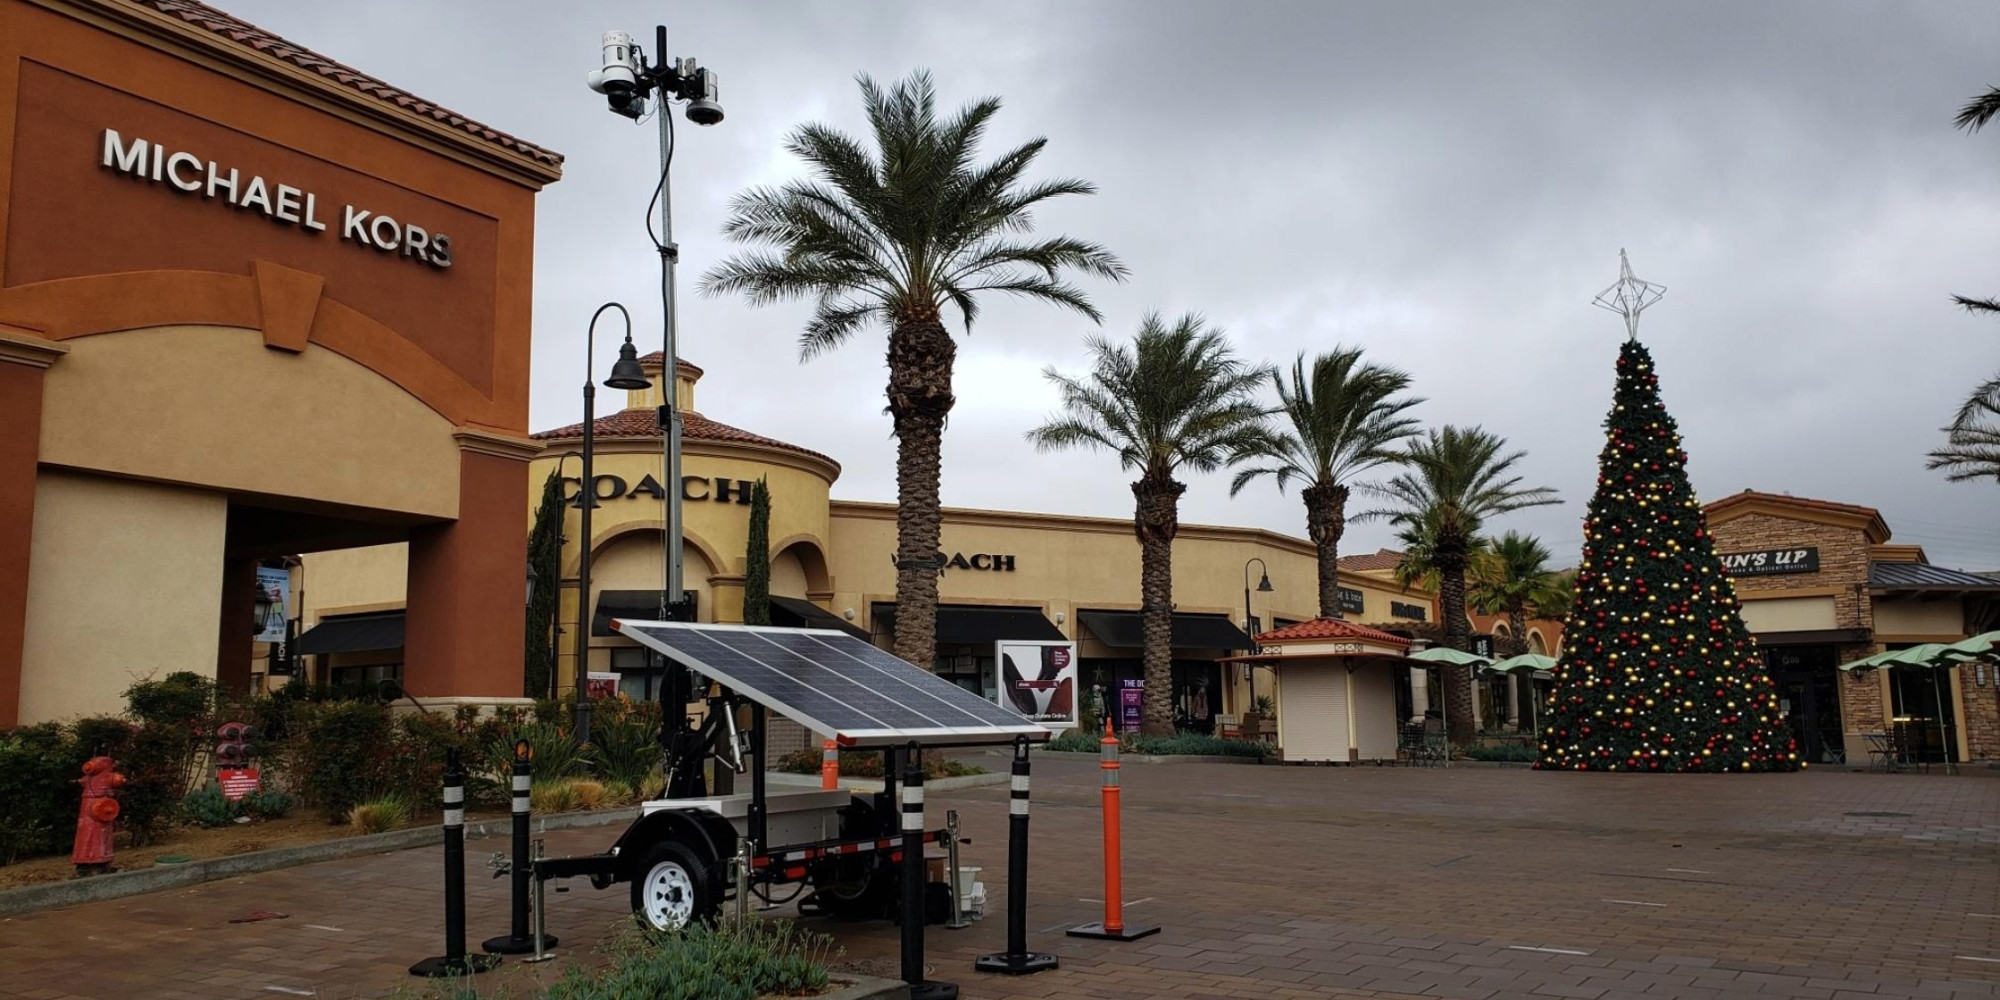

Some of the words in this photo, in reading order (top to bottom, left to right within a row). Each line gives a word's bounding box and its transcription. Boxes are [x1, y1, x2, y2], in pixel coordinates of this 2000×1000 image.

[102, 128, 326, 231] MICHAEL
[344, 205, 452, 268] KORS
[560, 473, 755, 505] COACH
[934, 552, 1016, 572] OACH
[1718, 552, 1767, 568] UN'S
[1776, 550, 1807, 564] UP
[278, 641, 286, 661] ACH
